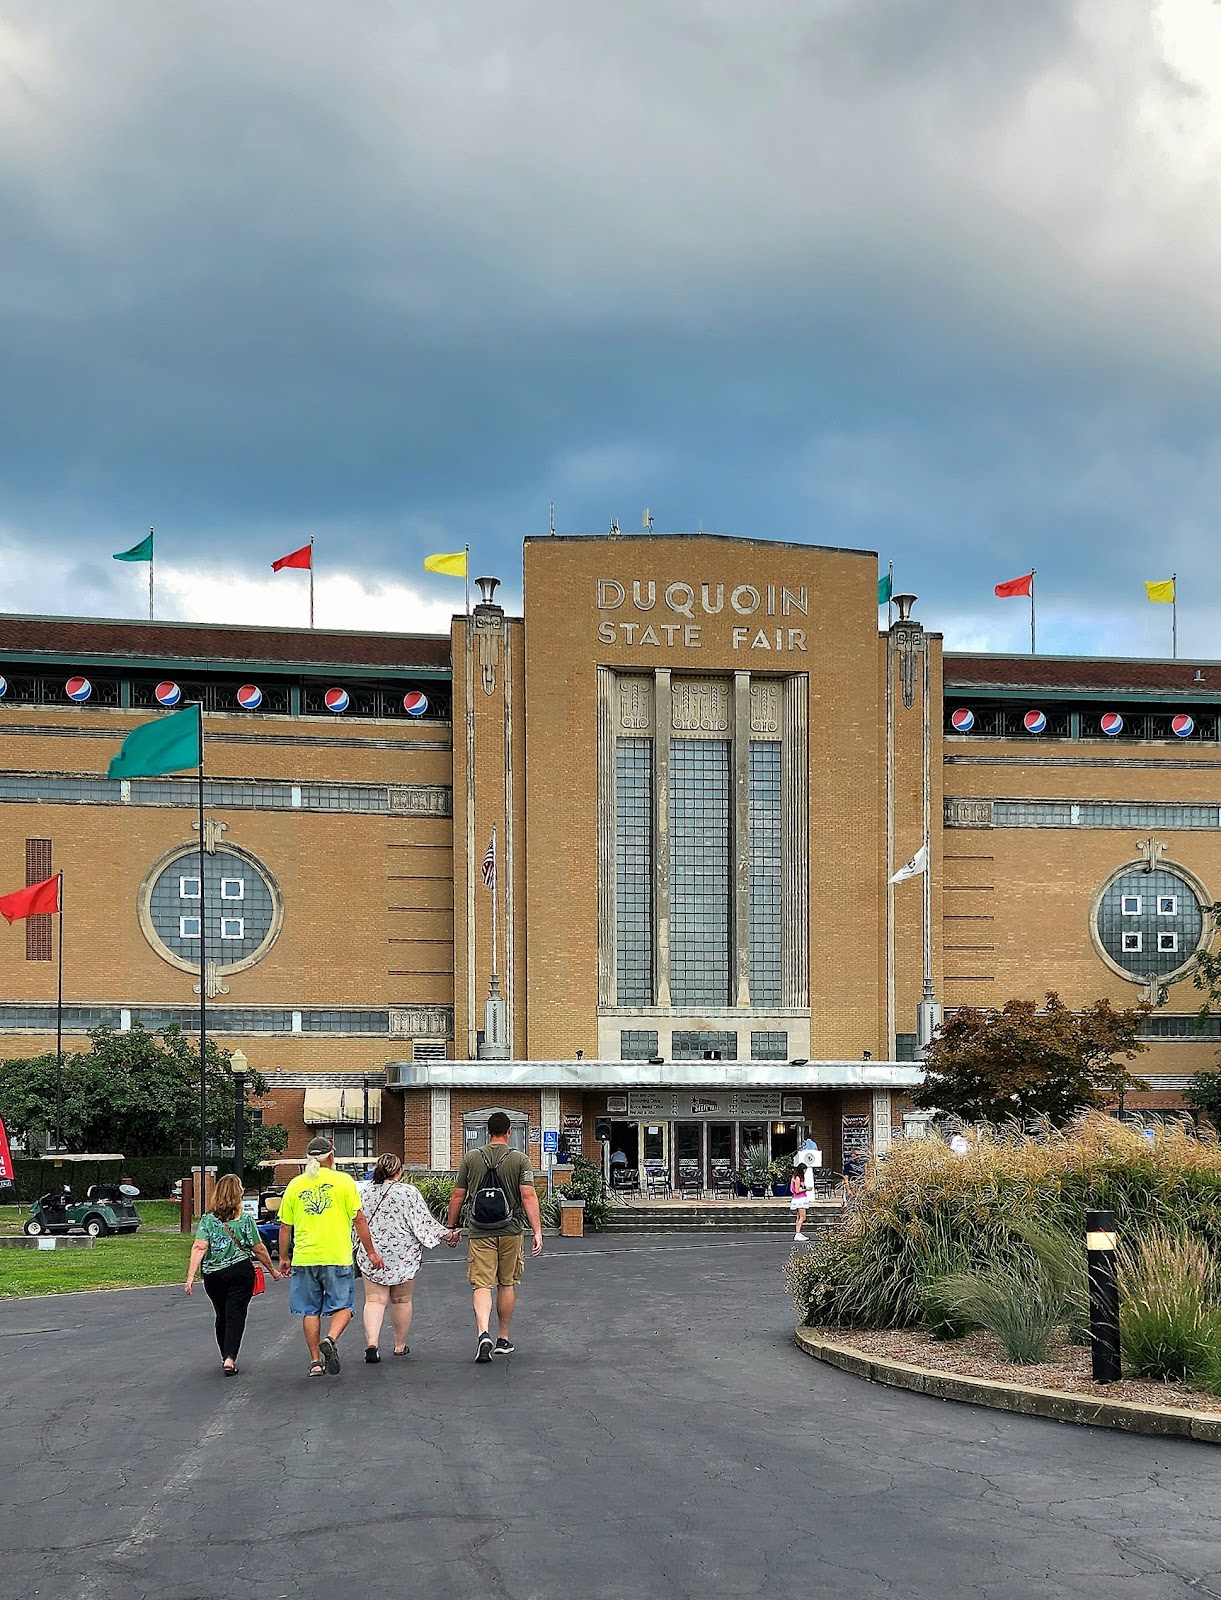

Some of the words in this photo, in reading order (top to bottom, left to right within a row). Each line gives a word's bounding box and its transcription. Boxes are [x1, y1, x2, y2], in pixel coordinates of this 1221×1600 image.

[597, 578, 809, 619] DUQUOIN
[597, 621, 702, 648] STATE
[732, 626, 808, 651] FAIR
